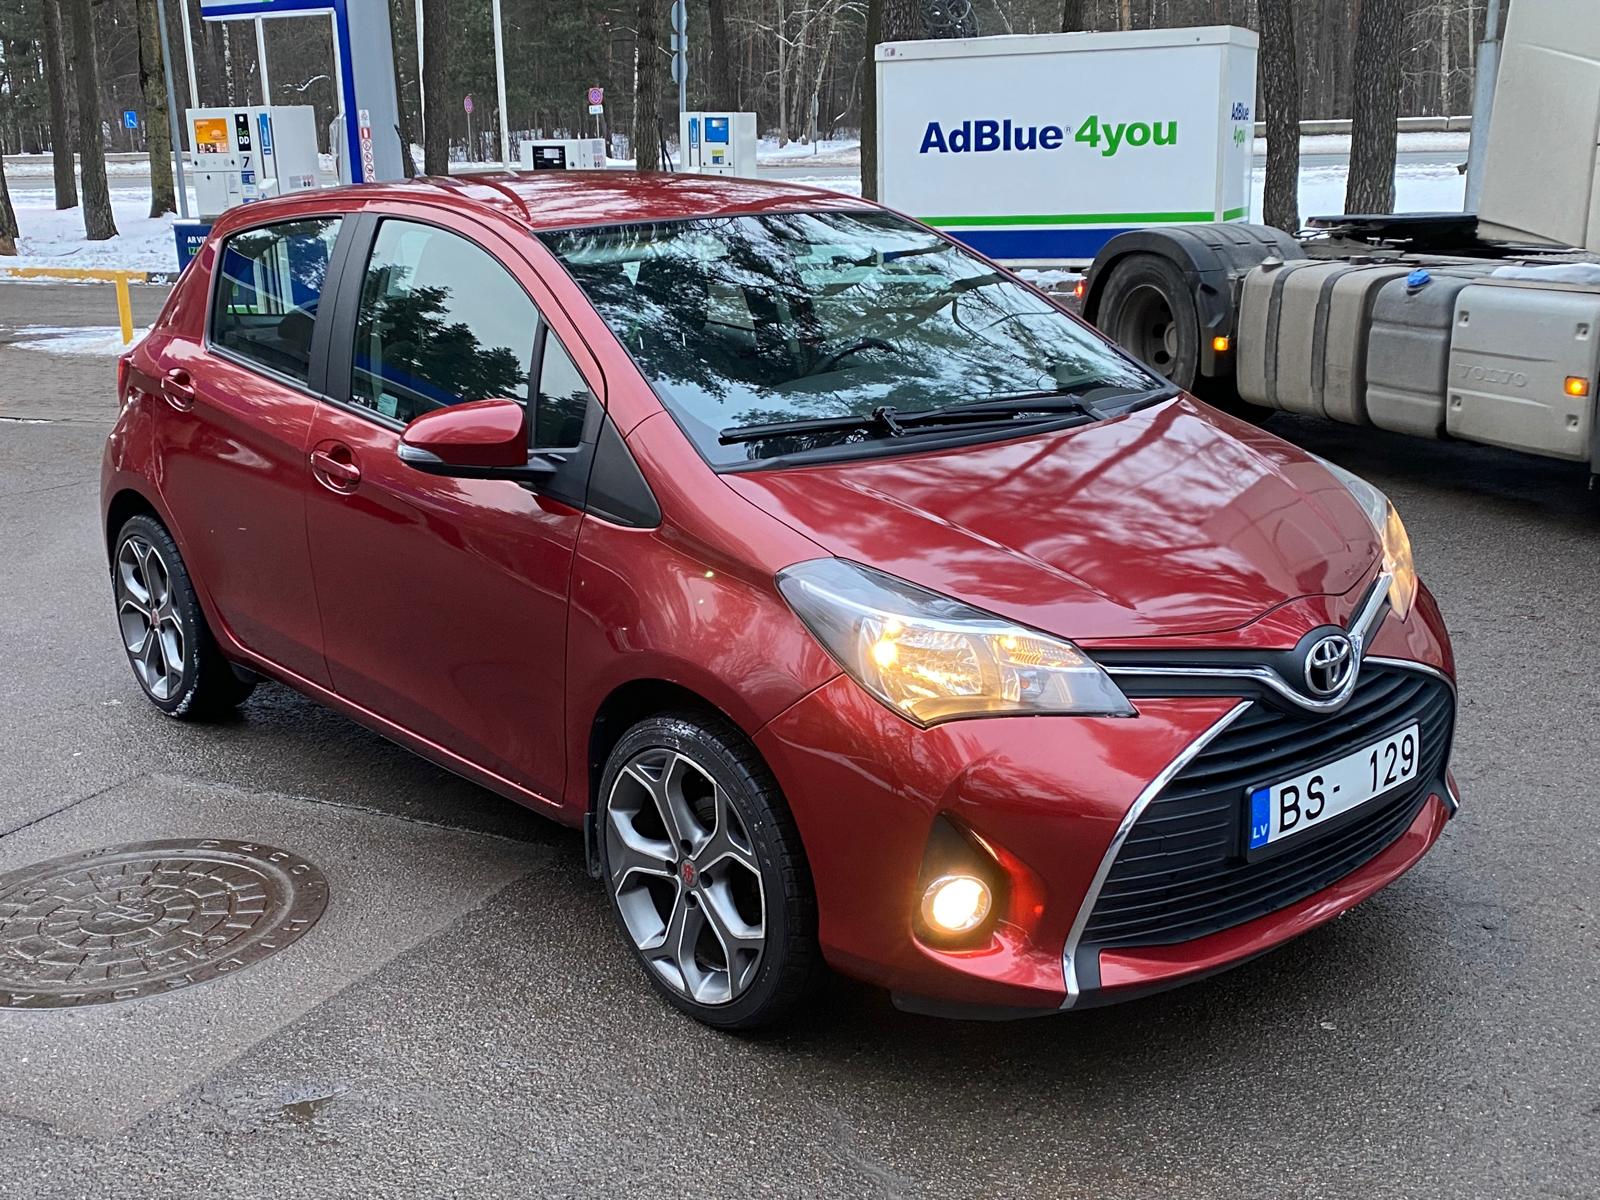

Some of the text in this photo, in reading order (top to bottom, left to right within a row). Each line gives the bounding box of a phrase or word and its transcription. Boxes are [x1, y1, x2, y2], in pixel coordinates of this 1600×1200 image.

[239, 136, 249, 144] DD
[919, 115, 1178, 157] AdBlue 4you
[243, 156, 250, 168] 7
[1455, 363, 1528, 388] VOLVO
[1369, 733, 1415, 793] 129
[1252, 823, 1268, 839] LV
